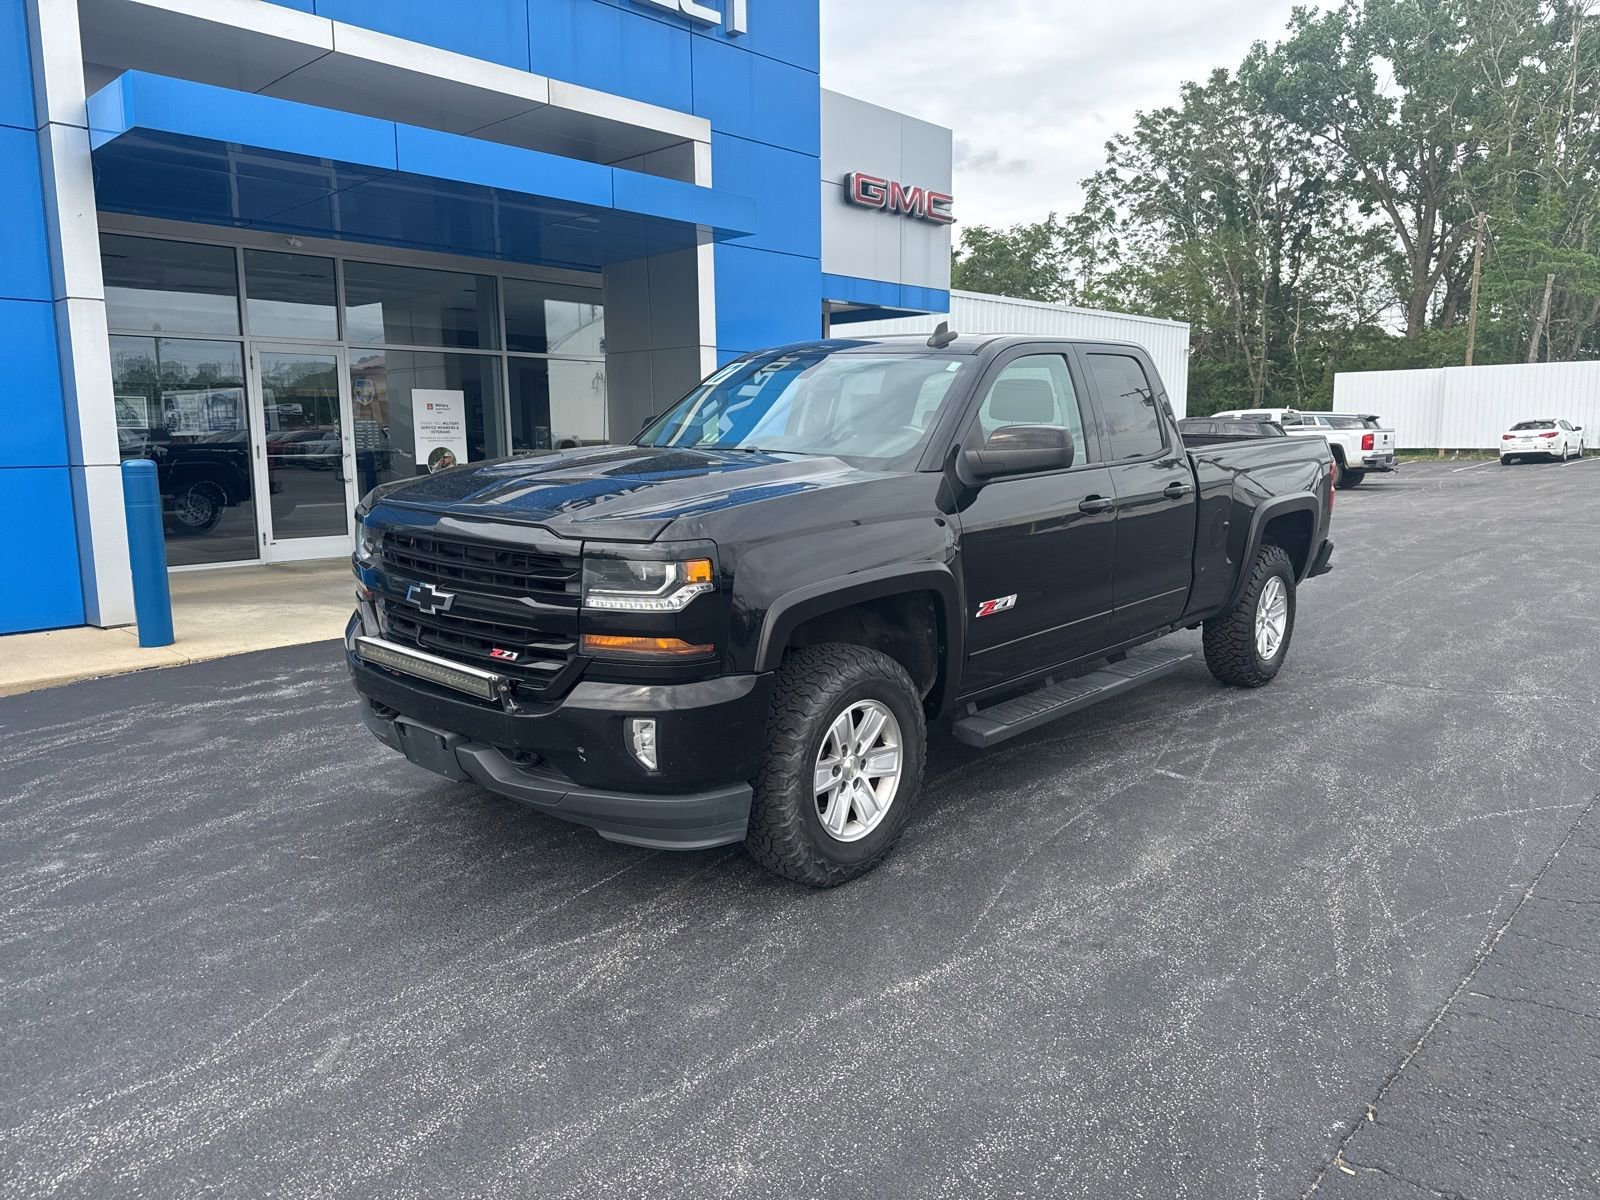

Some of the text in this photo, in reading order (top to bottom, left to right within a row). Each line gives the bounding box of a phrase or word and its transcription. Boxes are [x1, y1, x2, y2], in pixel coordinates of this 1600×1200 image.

[845, 171, 956, 225] GMC
[975, 593, 1018, 618] Z71
[489, 648, 519, 662] Z71
